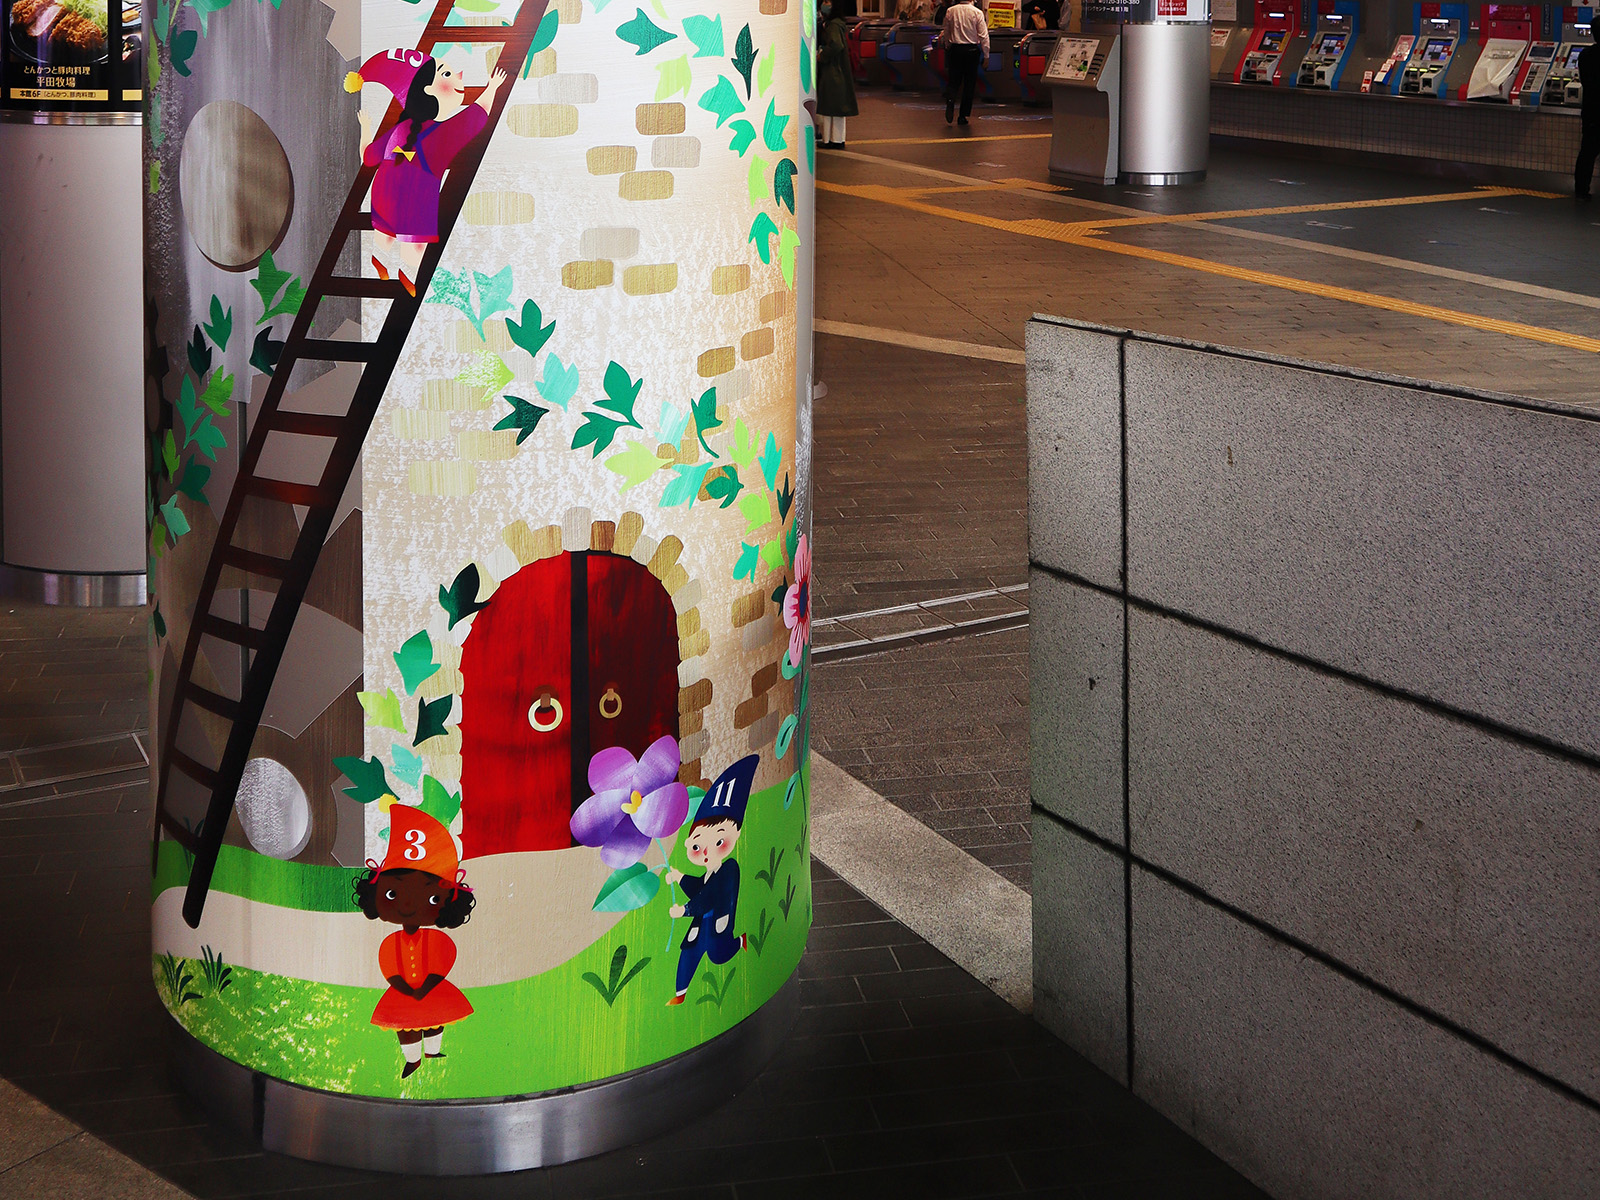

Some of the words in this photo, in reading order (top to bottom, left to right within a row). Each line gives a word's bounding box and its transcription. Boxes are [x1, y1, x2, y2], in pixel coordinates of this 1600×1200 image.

[36, 76, 76, 88] 平田牧場
[710, 777, 737, 809] 11
[403, 828, 428, 861] 3
